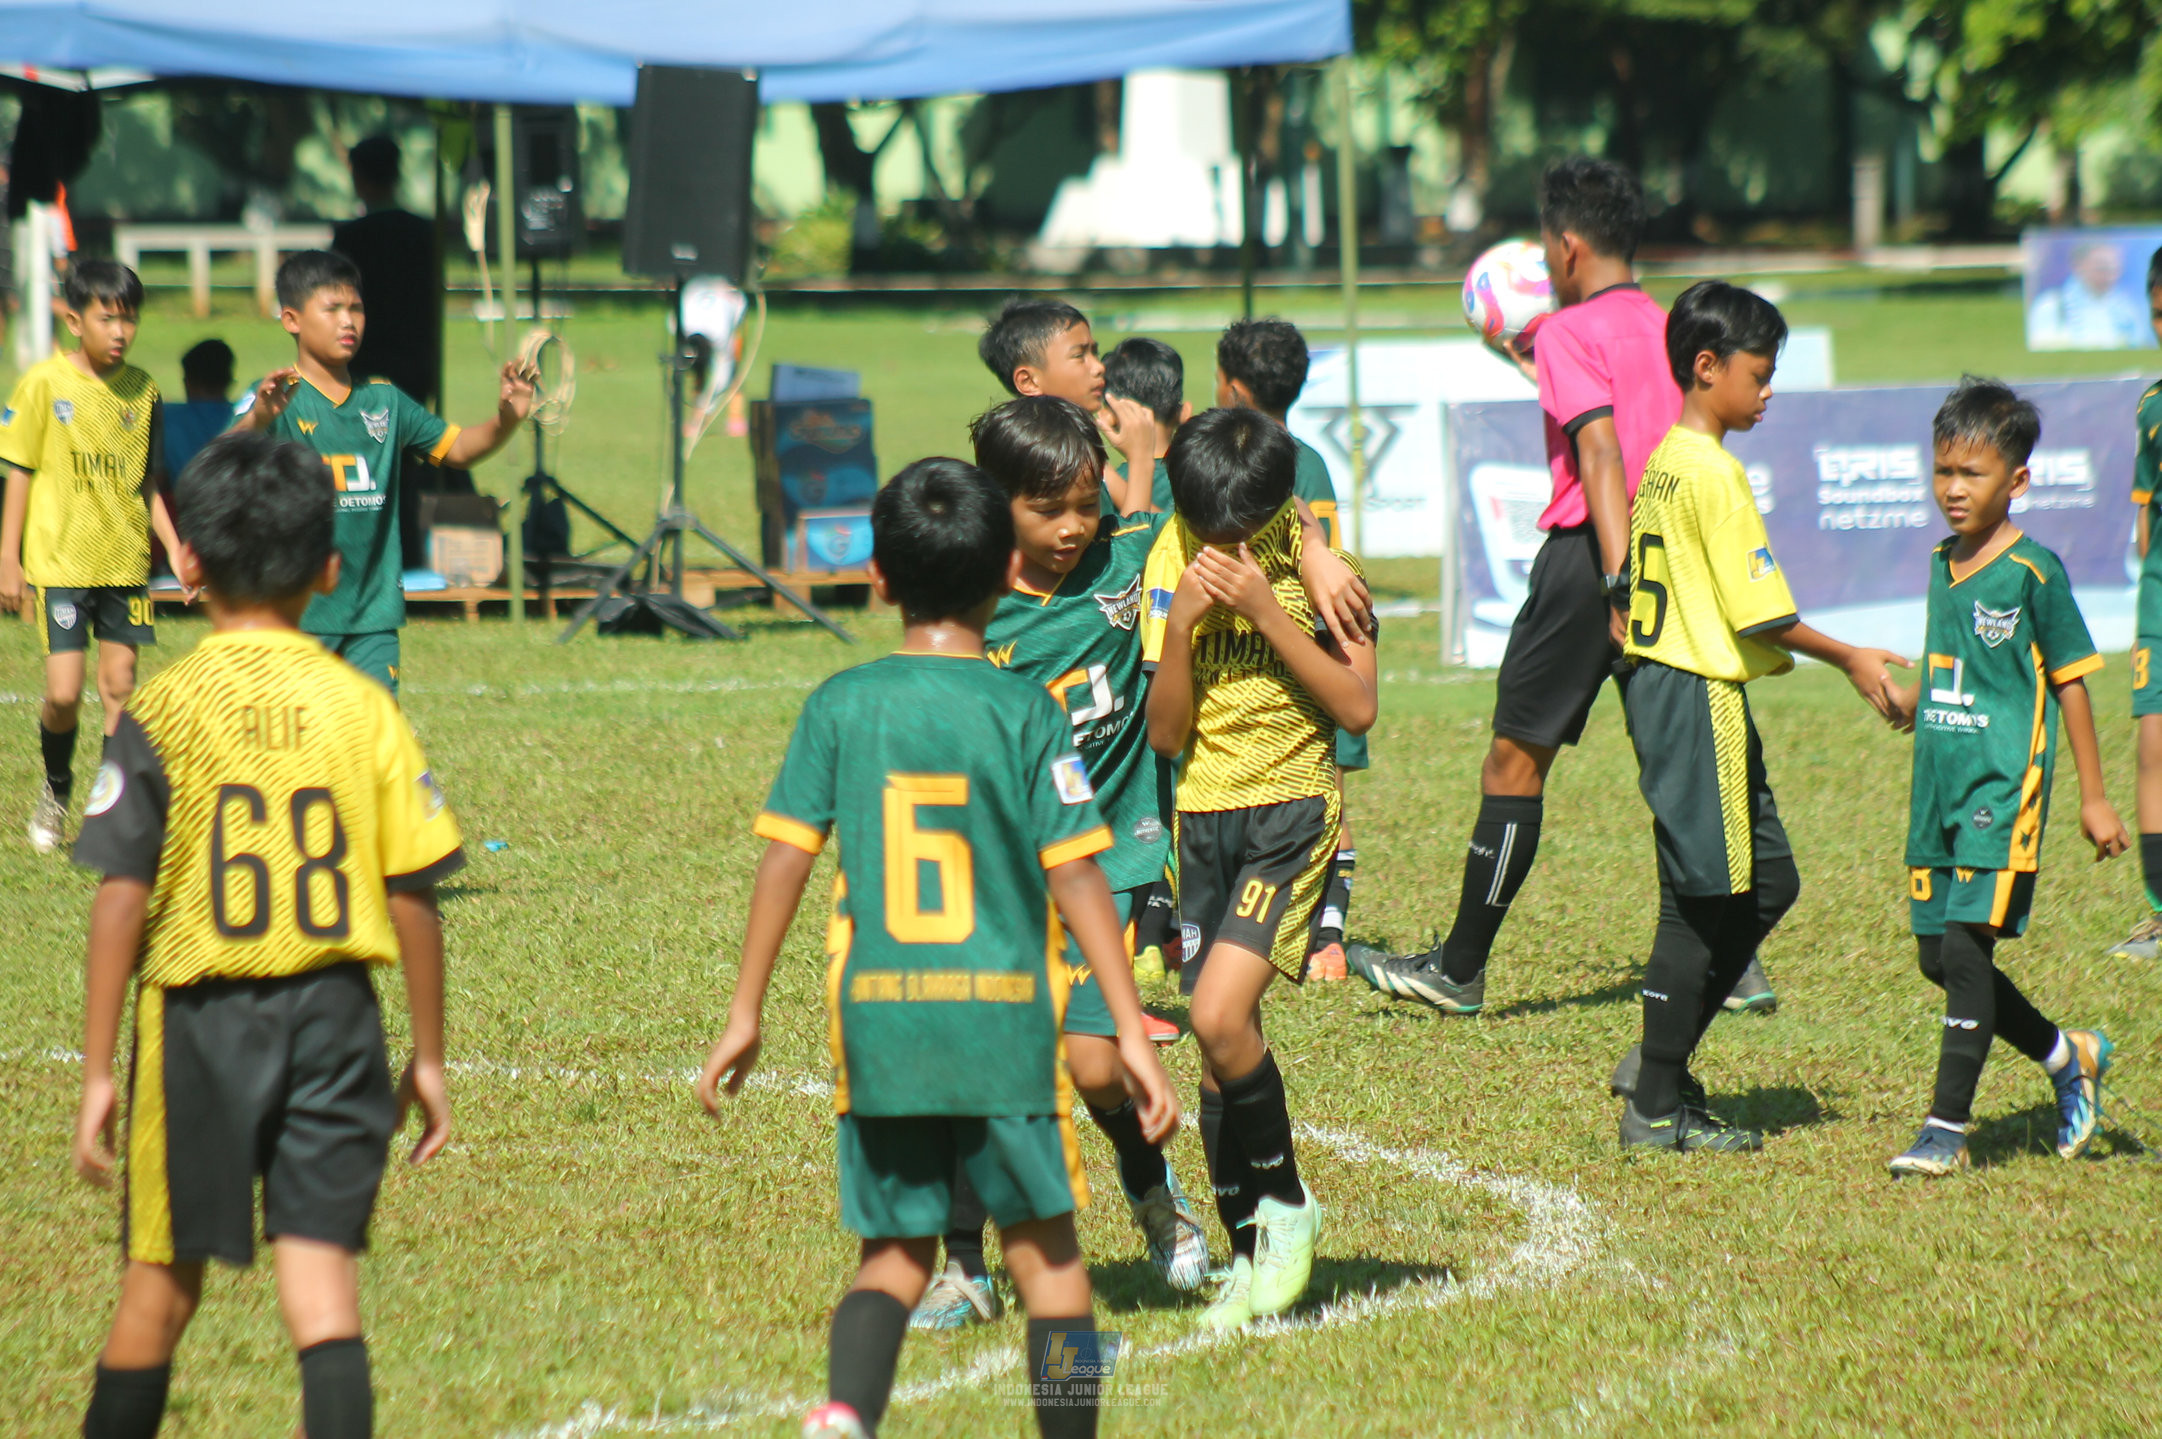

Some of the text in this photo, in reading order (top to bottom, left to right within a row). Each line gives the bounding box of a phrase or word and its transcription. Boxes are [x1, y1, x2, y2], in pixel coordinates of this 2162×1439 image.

[1819, 506, 1929, 530] netzme
[128, 597, 154, 627] 90
[210, 782, 350, 938] 68
[883, 773, 975, 944] 6
[1236, 880, 1277, 924] 91
